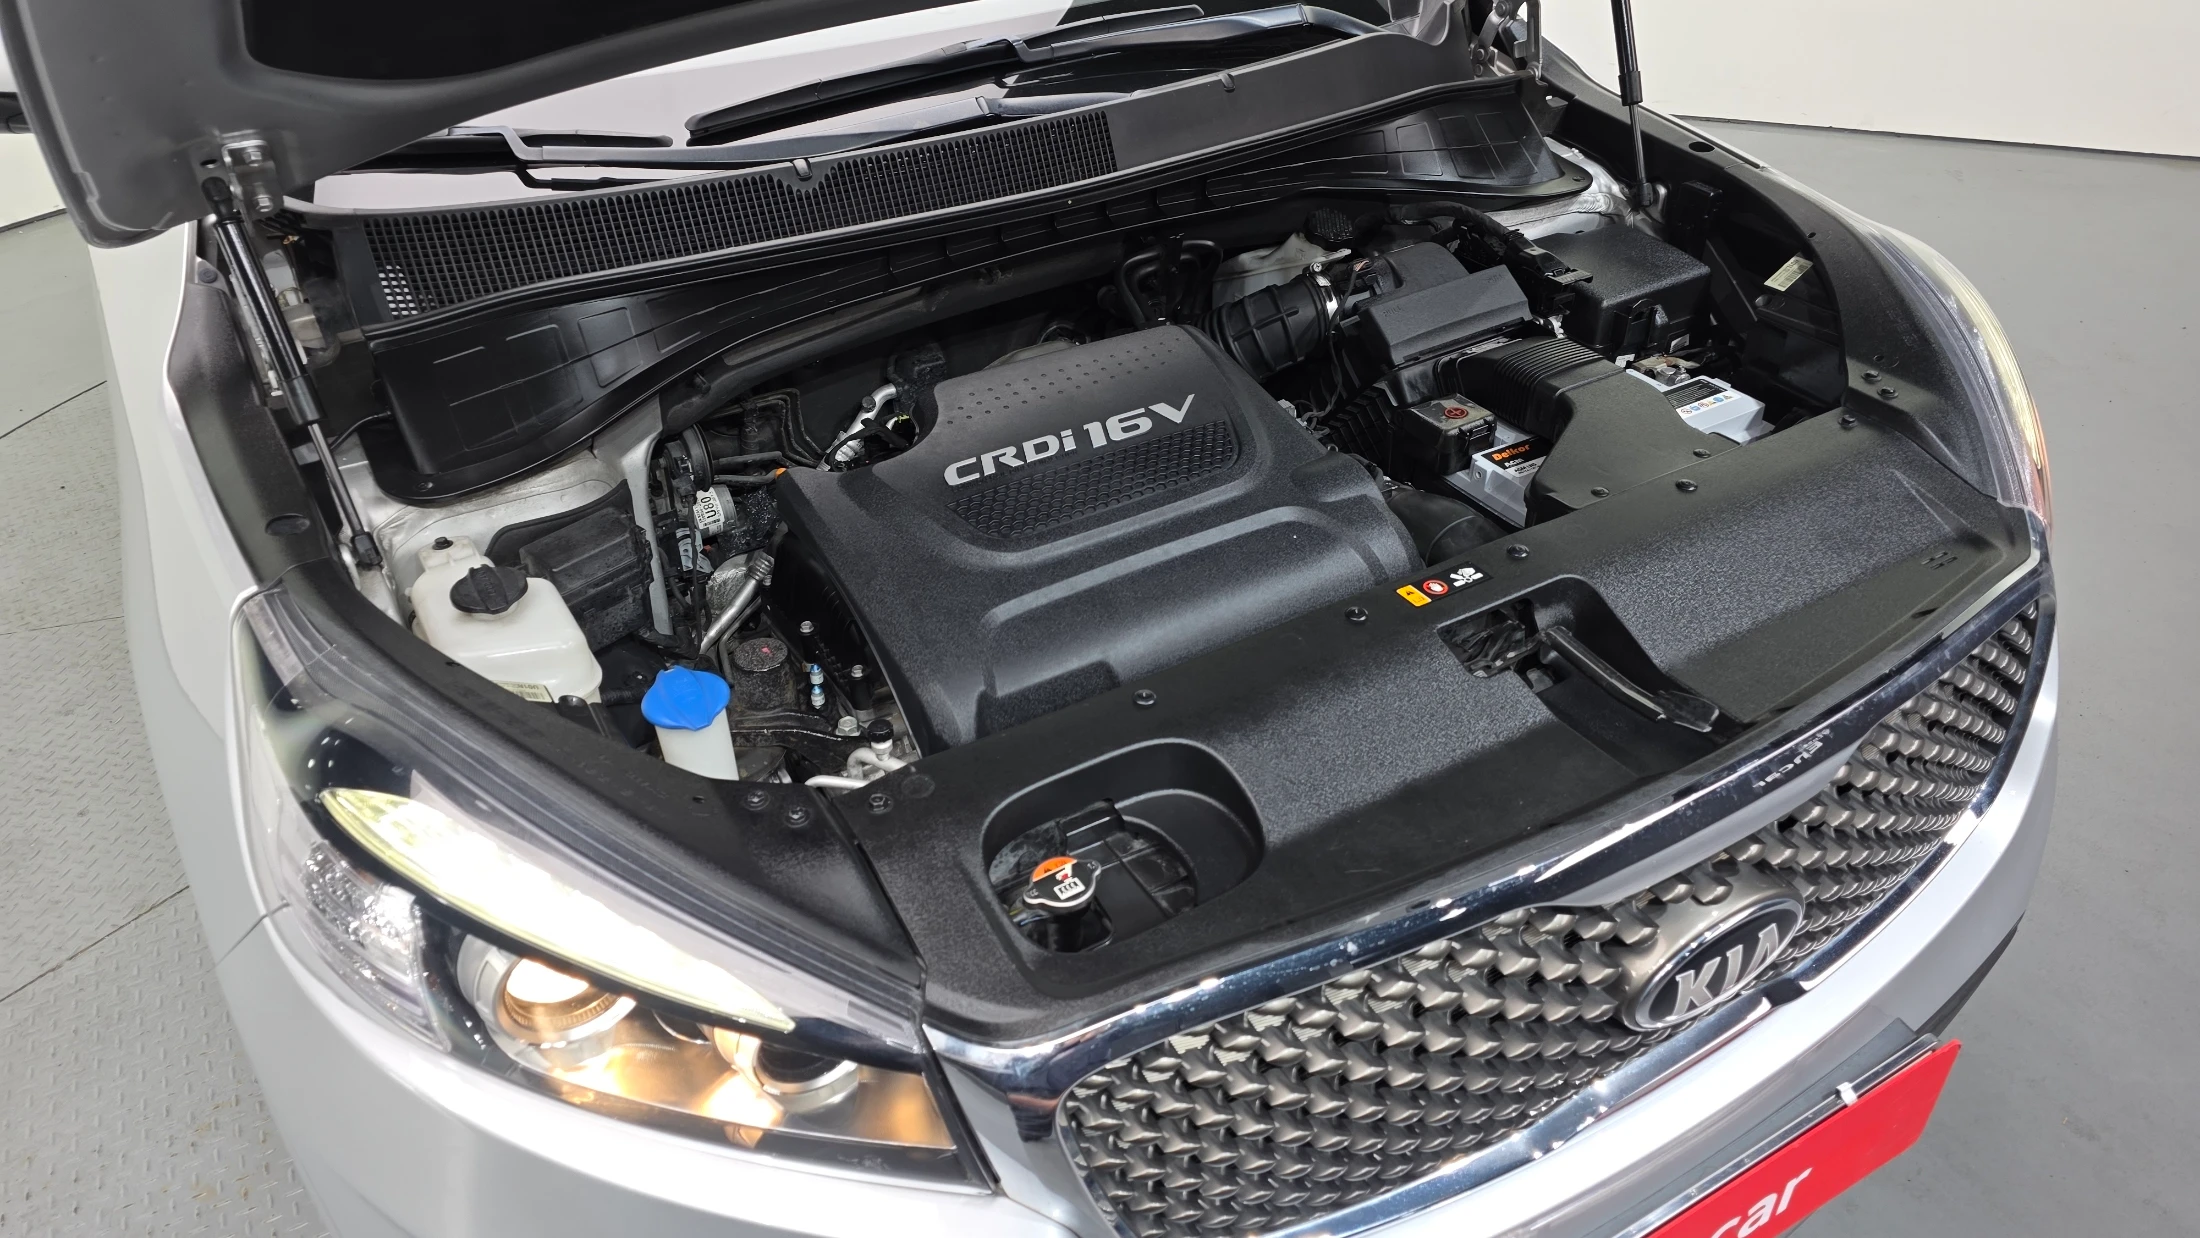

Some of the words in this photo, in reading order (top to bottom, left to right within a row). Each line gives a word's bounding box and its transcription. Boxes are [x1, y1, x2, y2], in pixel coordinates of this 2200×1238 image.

[943, 428, 1077, 487] CRDi
[1083, 393, 1196, 449] 16V
[1491, 443, 1530, 461] Delkor
[1673, 921, 1780, 1018] KIA
